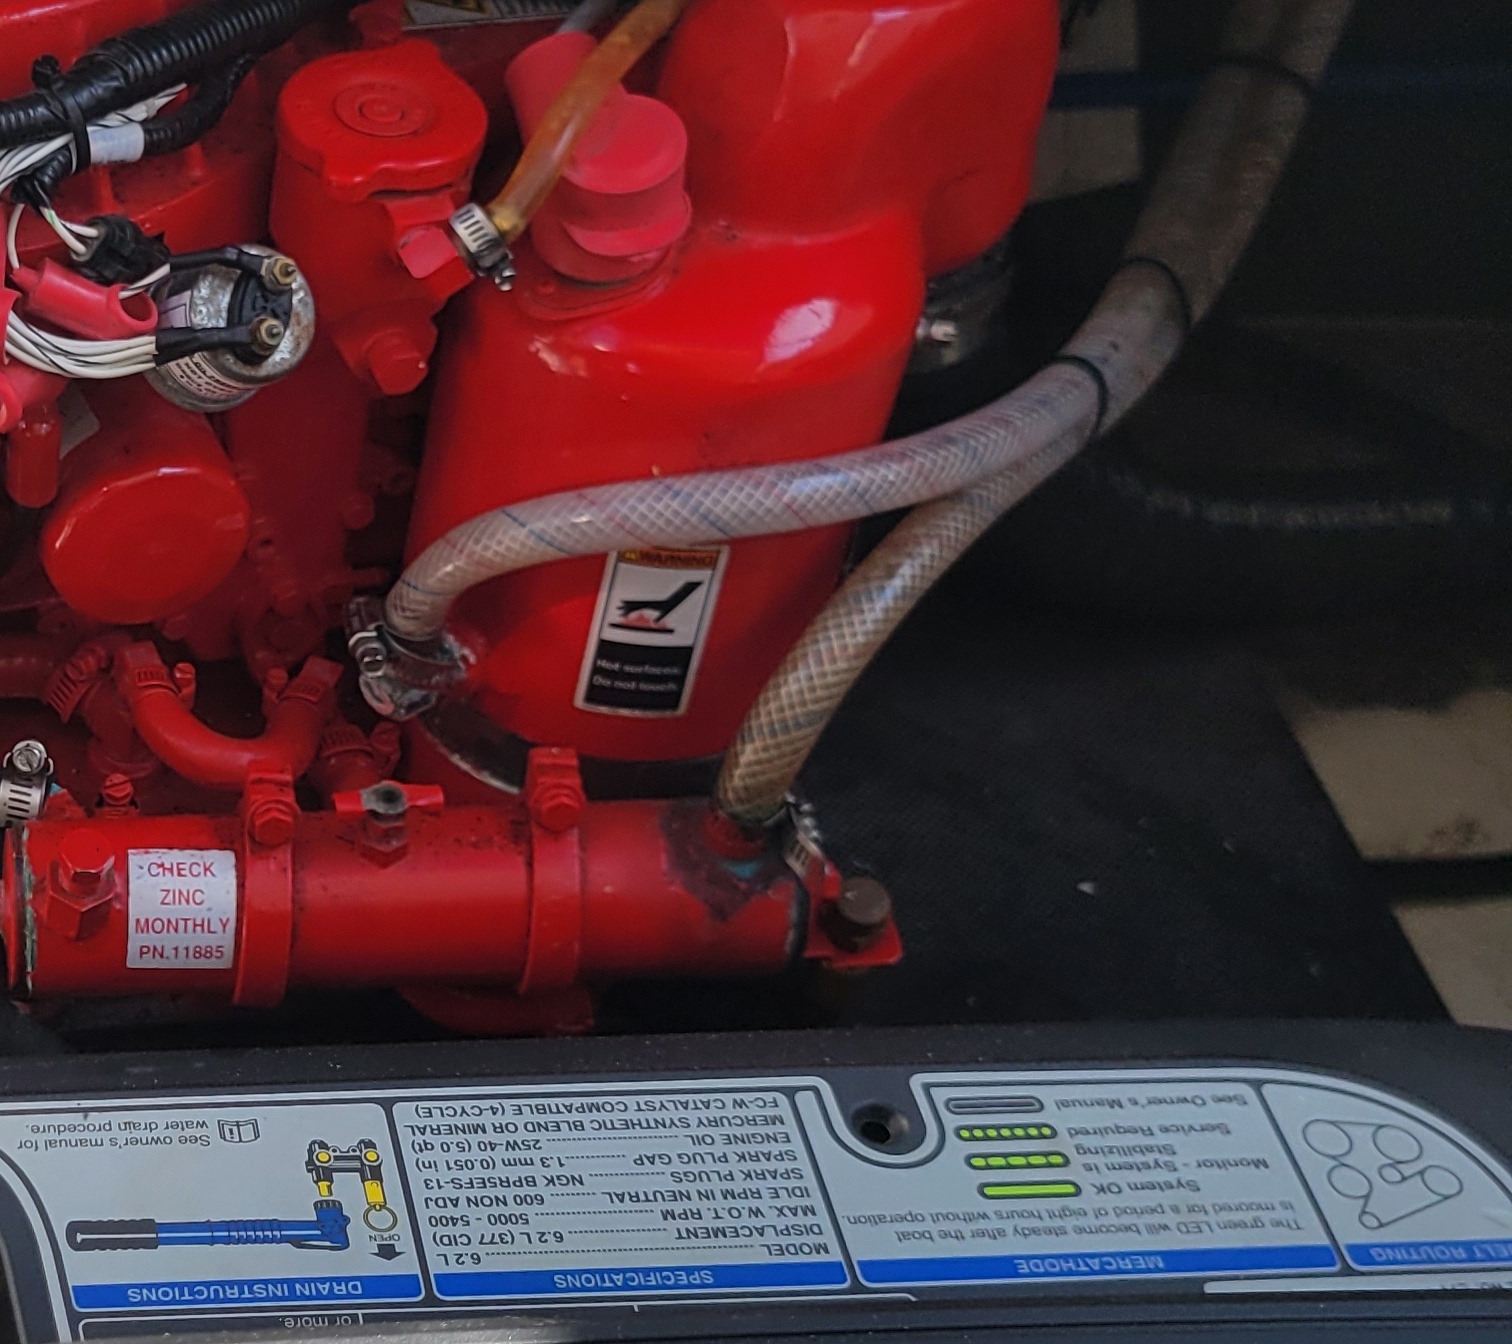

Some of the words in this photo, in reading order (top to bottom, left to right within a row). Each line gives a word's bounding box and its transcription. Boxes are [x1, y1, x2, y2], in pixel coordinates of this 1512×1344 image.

[592, 675, 612, 687] Do
[613, 680, 636, 690] not
[147, 860, 217, 878] CHECK
[159, 888, 206, 906] ZINC
[135, 917, 231, 936] MONTHLY
[138, 943, 225, 961] PN.11885
[633, 1098, 726, 1113] CATALYST
[732, 1096, 780, 1110] FC-W
[1053, 1096, 1125, 1113] Manual
[1126, 1095, 1207, 1110] Owner's
[1209, 1093, 1249, 1107] See
[414, 1101, 506, 1119] (4-CYCLE)
[509, 1101, 629, 1116] COMPATIBLE
[25, 1119, 113, 1136] procedure.
[117, 1120, 159, 1134] drain
[163, 1119, 209, 1131] water
[492, 1121, 519, 1134] OR
[523, 1119, 586, 1133] BLEND
[590, 1116, 692, 1131] SYNTHETIC
[695, 1114, 785, 1129] MERCURY
[1157, 1121, 1232, 1136] Service
[403, 1122, 488, 1137] MINERAL
[1065, 1122, 1156, 1138] Required
[17, 1138, 40, 1153] for
[44, 1136, 105, 1151] manual
[108, 1135, 174, 1150] owner's
[177, 1133, 212, 1147] See
[439, 1138, 472, 1154] (5.0
[477, 1138, 543, 1152] 25W-40
[683, 1133, 715, 1147] OIL
[722, 1131, 791, 1146] ENGINE
[411, 1139, 435, 1155] qt)
[1073, 1142, 1178, 1157] Stabilizing
[501, 1156, 535, 1167] mm
[540, 1156, 566, 1169] 1.3
[632, 1152, 673, 1166] GAP
[675, 1150, 729, 1165] PLUG
[736, 1148, 798, 1164] SPARK
[1194, 1156, 1270, 1171] Monitor
[415, 1157, 439, 1173] in)
[445, 1156, 497, 1172] (0.051
[1080, 1161, 1101, 1176] is
[1104, 1158, 1179, 1173] System
[544, 1174, 585, 1188] NGK
[669, 1170, 735, 1184] PLUGS
[739, 1167, 804, 1182] SPARK
[423, 1175, 538, 1191] BPR5EFS-13
[1089, 1181, 1124, 1196] OK
[1124, 1176, 1202, 1193] System
[513, 1193, 545, 1206] 600
[601, 1190, 691, 1204] NEUTRAL
[693, 1189, 716, 1201] IN
[721, 1187, 763, 1200] RPM
[769, 1186, 811, 1199] IDLE
[423, 1196, 460, 1210] ADJ
[466, 1194, 508, 1208] NON
[1170, 1203, 1182, 1214] a
[1211, 1200, 1276, 1213] moored
[1277, 1199, 1295, 1212] is
[660, 1208, 701, 1222] RPM
[706, 1206, 766, 1219] W.O.T.
[768, 1204, 817, 1217] MAX.
[993, 1207, 1044, 1222] hours
[1045, 1204, 1088, 1221] eight
[1091, 1206, 1110, 1219] of
[1112, 1203, 1166, 1218] period
[1185, 1202, 1209, 1216] for
[428, 1213, 470, 1228] 5400
[486, 1212, 530, 1226] 5000
[842, 1210, 926, 1228] operation.
[930, 1210, 989, 1225] without
[1215, 1216, 1266, 1231] green
[1268, 1217, 1306, 1231] The
[675, 1223, 823, 1239] DISPLACEMENT
[936, 1228, 966, 1242] the
[969, 1226, 1008, 1241] after
[1011, 1223, 1069, 1240] steady
[1071, 1222, 1143, 1237] become
[1144, 1221, 1173, 1236] will
[1175, 1220, 1214, 1235] LED
[369, 1233, 401, 1243] OPEN
[432, 1231, 472, 1247] CID)
[477, 1229, 515, 1246] (377
[518, 1232, 533, 1245] L
[536, 1230, 564, 1244] 6.2
[893, 1229, 935, 1244] boat
[759, 1242, 831, 1256] MODEL
[1368, 1244, 1468, 1262] ROUTING
[436, 1253, 450, 1267] L
[455, 1252, 482, 1266] 6.2
[1012, 1255, 1167, 1275] MERCATHODE
[553, 1269, 715, 1289] SPECIFICATIONS
[127, 1282, 289, 1304] INSTRUCTIONS
[294, 1279, 363, 1296] DRAIN
[279, 1316, 329, 1329] more.
[333, 1315, 352, 1326] or
